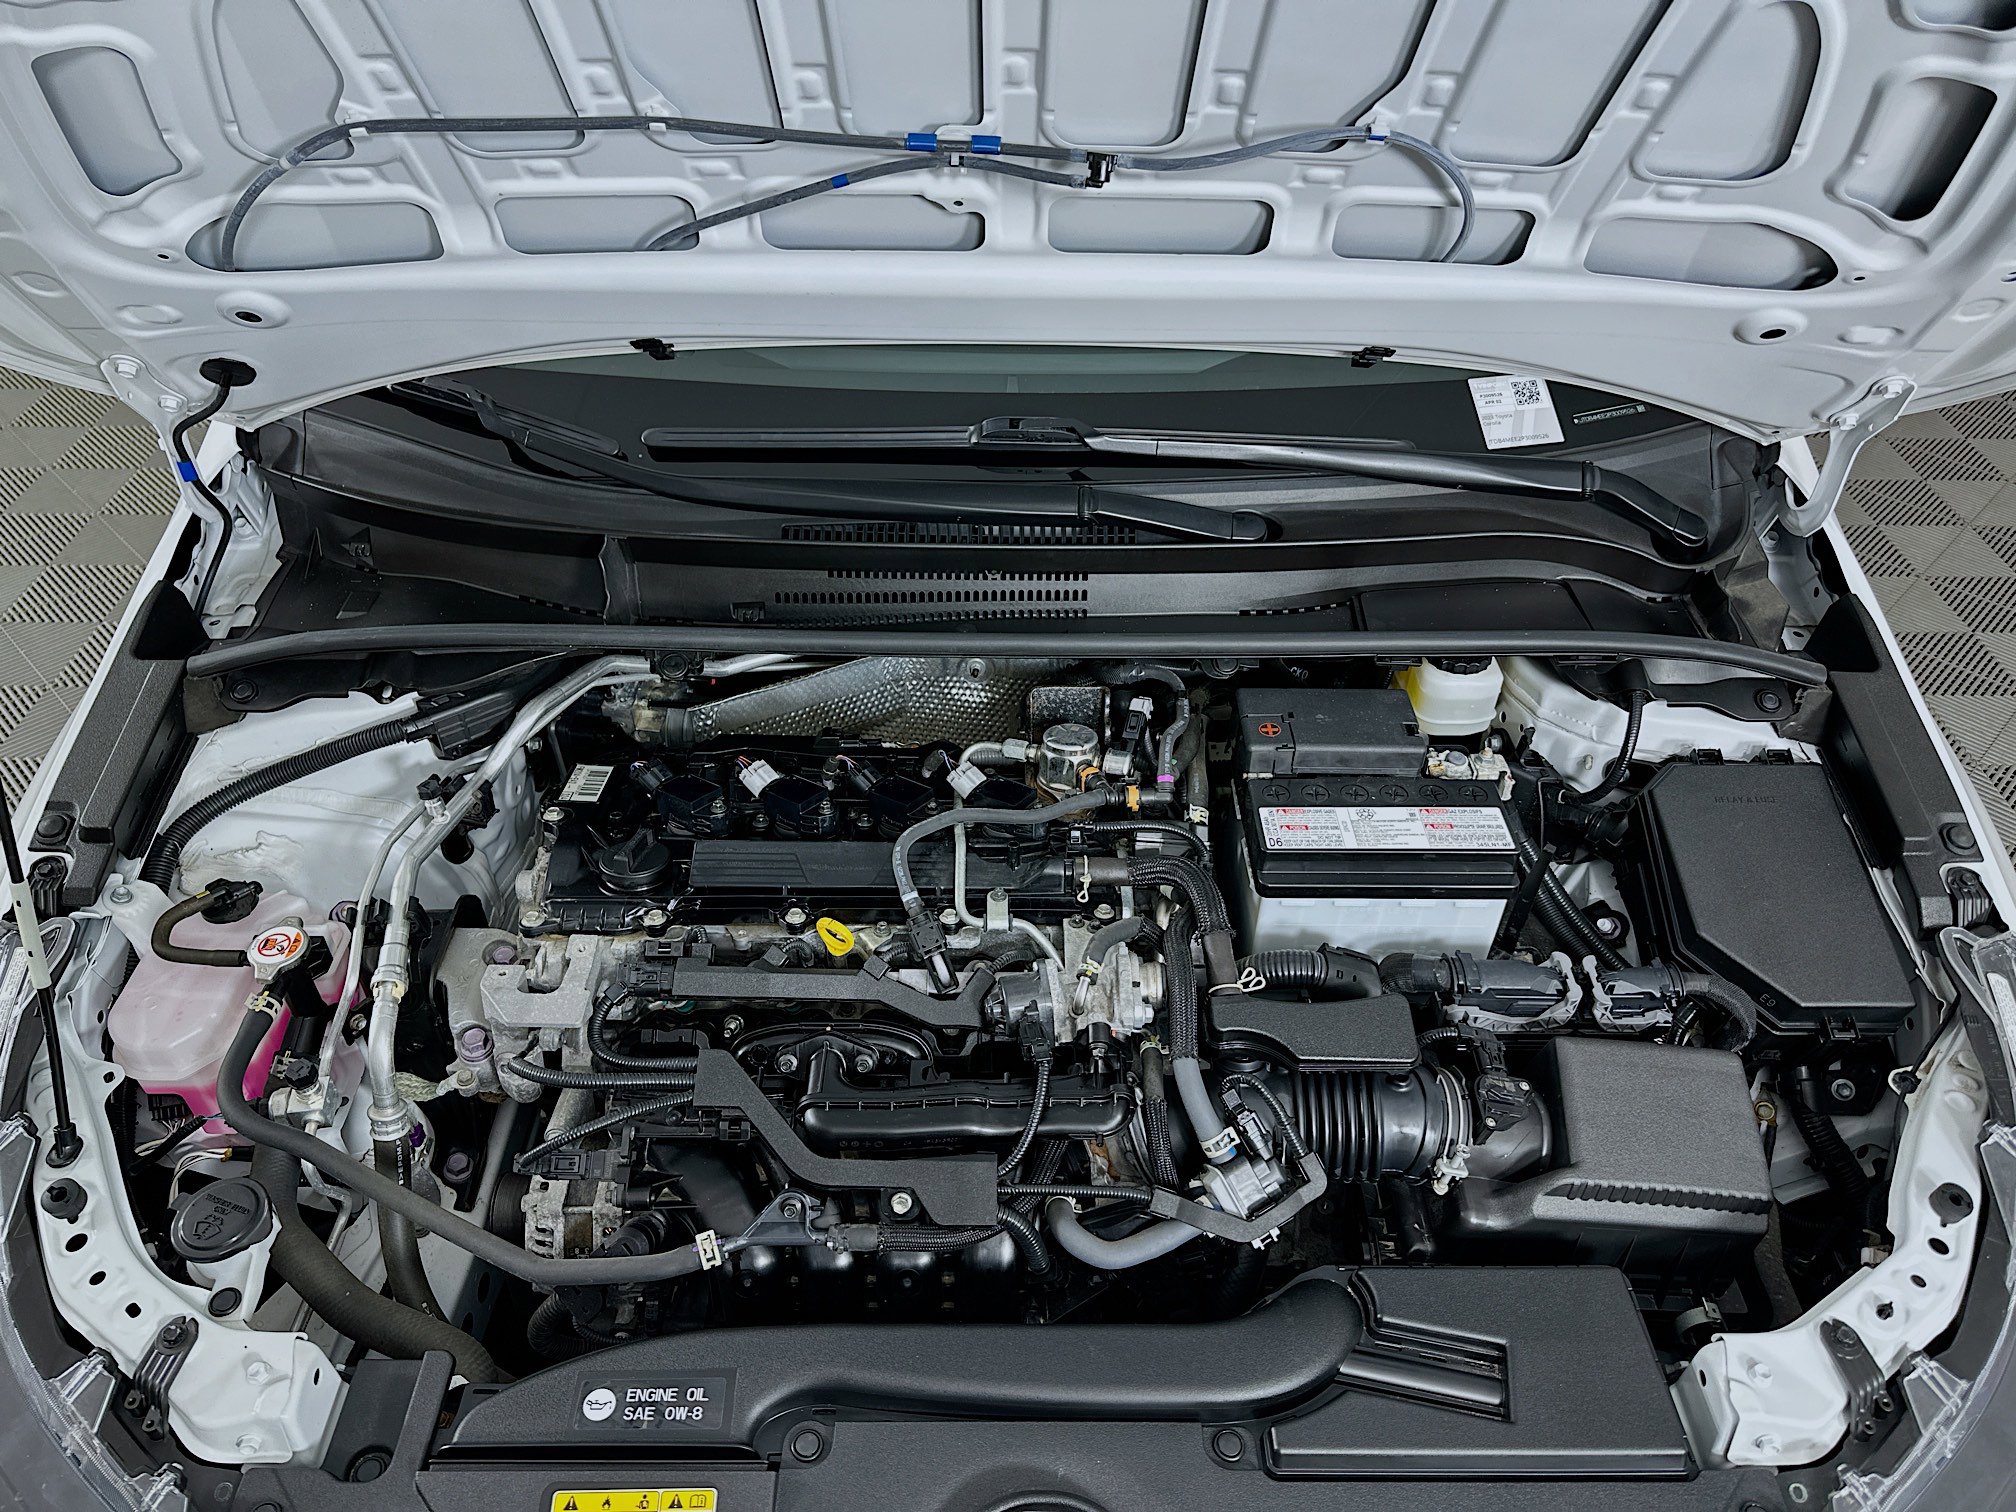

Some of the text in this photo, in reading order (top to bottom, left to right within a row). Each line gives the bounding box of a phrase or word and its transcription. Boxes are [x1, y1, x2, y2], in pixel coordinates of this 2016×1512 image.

[1269, 838, 1283, 847] D6
[625, 1387, 709, 1402] ENGINE OIL
[622, 1406, 703, 1421] SAE 0W-8
